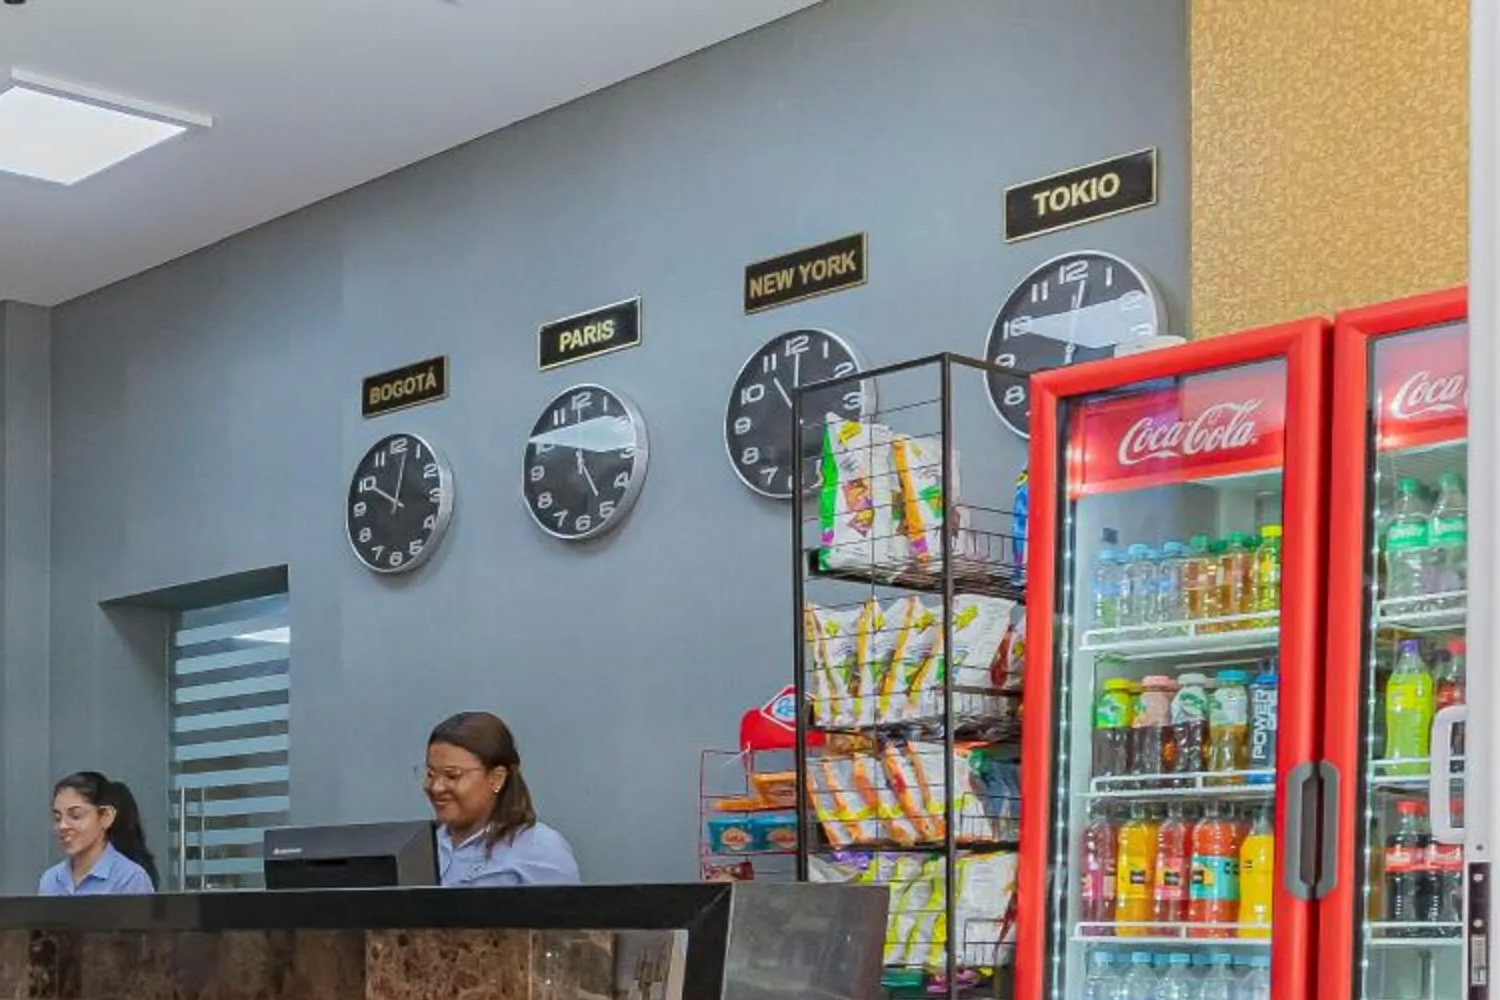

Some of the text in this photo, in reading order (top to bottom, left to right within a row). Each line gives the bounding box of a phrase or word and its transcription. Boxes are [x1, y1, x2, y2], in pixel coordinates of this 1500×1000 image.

[1032, 172, 1121, 216] TOKIO
[749, 250, 857, 298] NEW YORK
[1059, 260, 1089, 285] 12
[1105, 266, 1113, 287] 1
[1031, 280, 1049, 302] 11
[559, 319, 615, 353] PARIS
[784, 335, 810, 357] 12
[823, 340, 829, 359] 1
[763, 353, 777, 374] 11
[833, 361, 854, 379] 2
[369, 366, 437, 405] BOGOTÁ
[741, 383, 765, 405] 10
[1391, 370, 1468, 419] Coca
[571, 391, 593, 410] 12
[603, 395, 609, 412] 1
[842, 391, 863, 410] 3
[1004, 385, 1026, 406] 8
[553, 407, 566, 426] 11
[734, 417, 752, 435] 9
[1118, 398, 1264, 466] Coca-Cola
[389, 437, 408, 455] 12
[415, 443, 421, 460] 1
[375, 451, 385, 468] 11
[741, 447, 759, 465] 8
[423, 463, 437, 479] 2
[530, 465, 545, 482] 9
[613, 471, 630, 489] 4
[760, 466, 779, 485] 7
[359, 476, 377, 493] 10
[353, 501, 367, 517] 9
[537, 491, 553, 509] 8
[599, 500, 615, 518] 5
[553, 509, 569, 528] 7
[575, 515, 591, 531] 6
[359, 527, 372, 543] 8
[371, 545, 385, 560] 7
[409, 539, 423, 555] 5
[389, 551, 403, 566] 6
